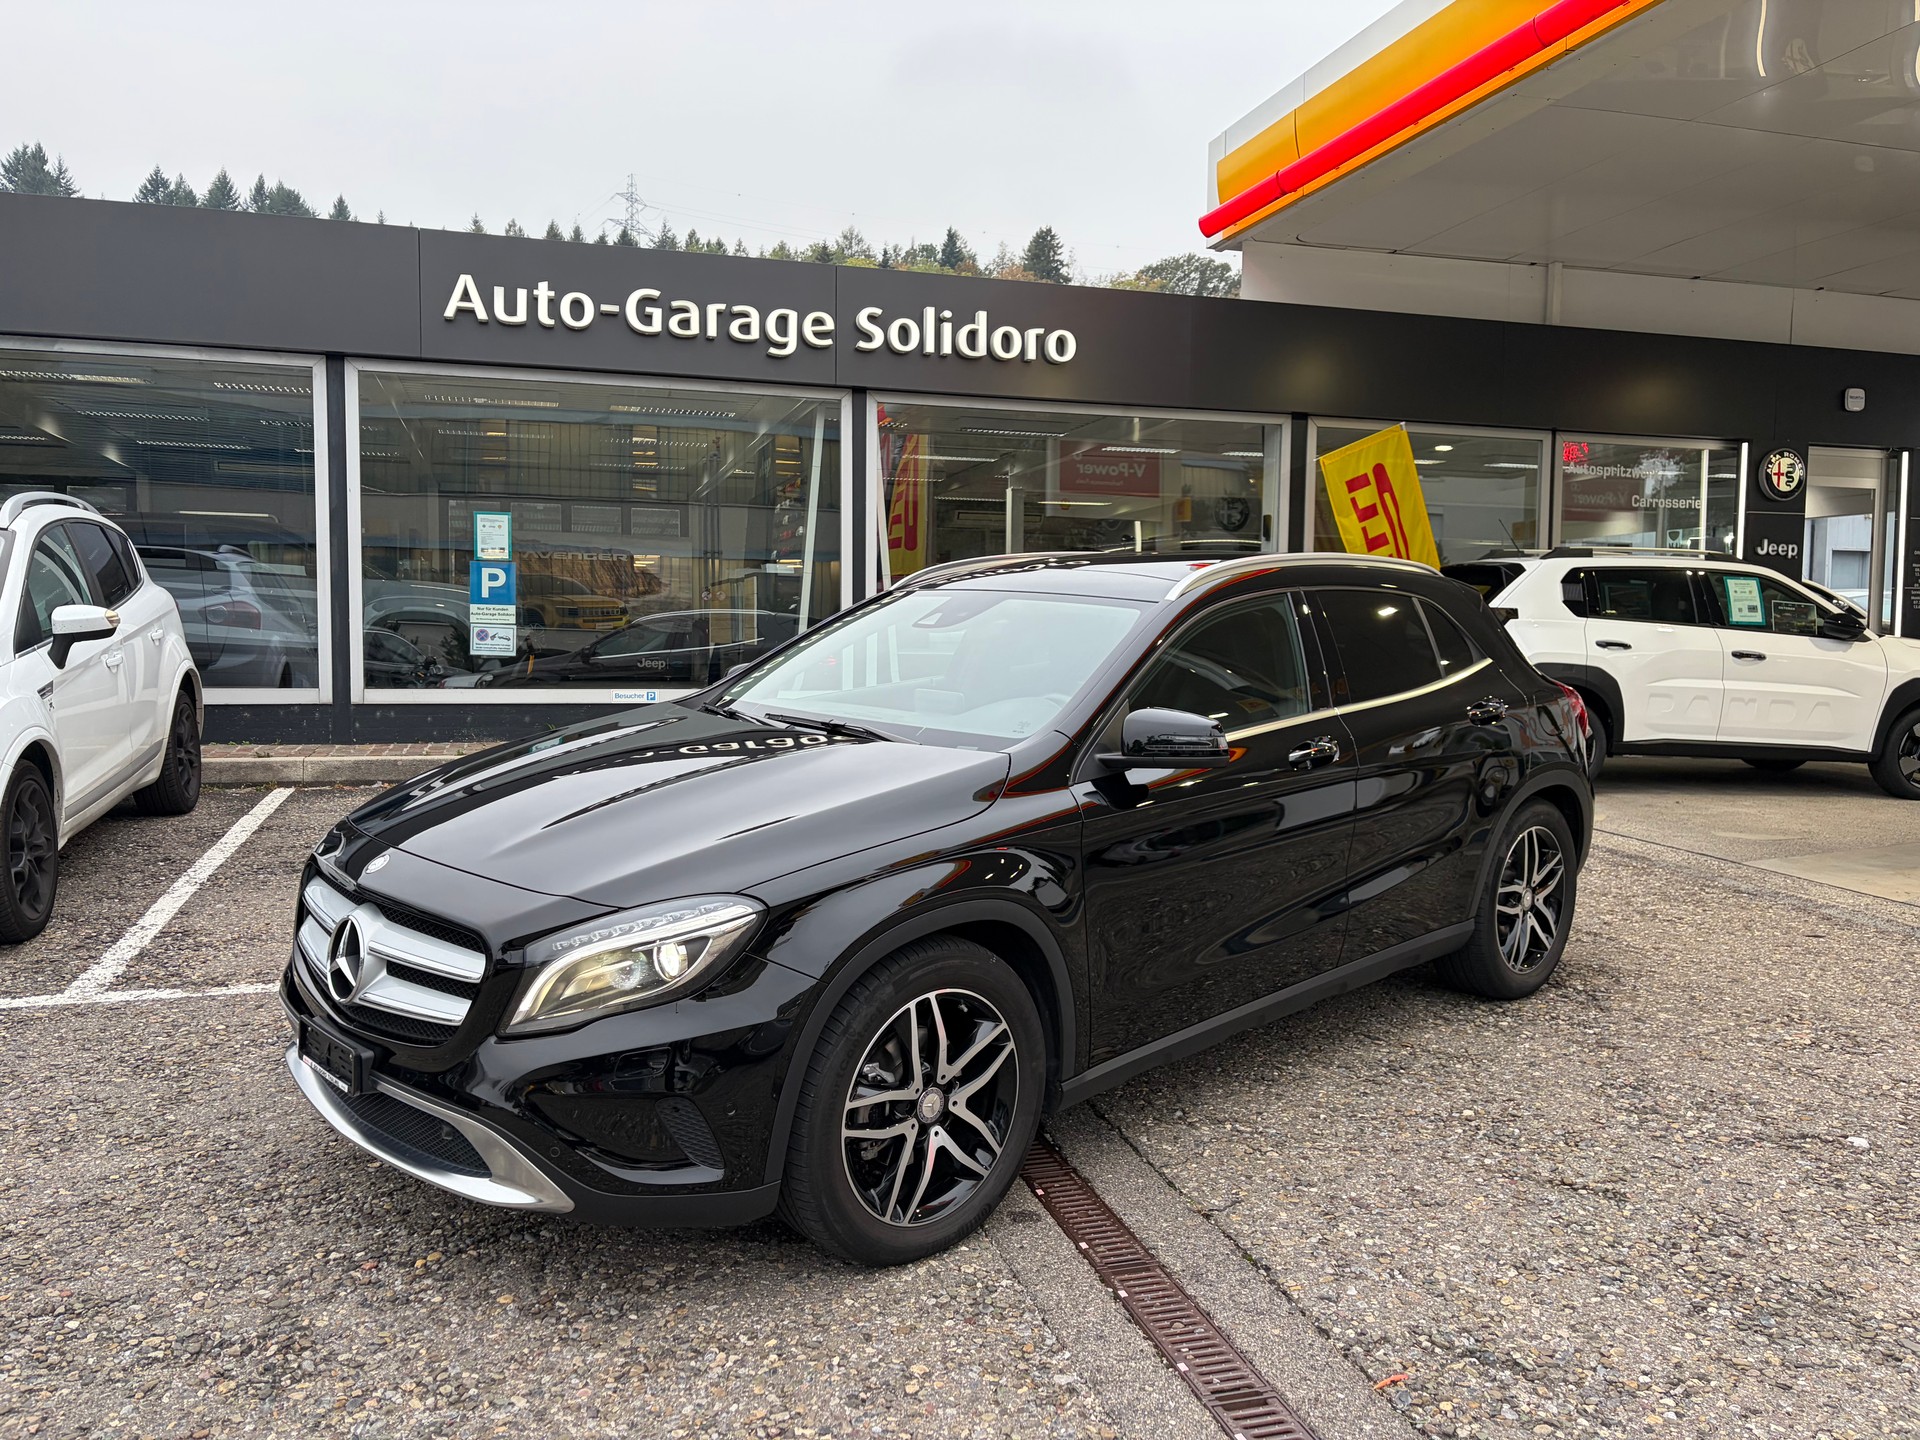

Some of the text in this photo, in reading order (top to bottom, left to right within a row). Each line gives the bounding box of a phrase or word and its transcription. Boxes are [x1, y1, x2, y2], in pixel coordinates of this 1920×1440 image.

[442, 272, 1079, 365] Auto-Garage Solidoro
[1568, 463, 1662, 481] Autospritzwe
[1766, 451, 1804, 477] ALFA ROMEO
[1631, 494, 1702, 510] Carrosserie
[520, 550, 628, 561] AVENGER
[1756, 538, 1799, 560] Jeep
[481, 567, 507, 598] P
[637, 658, 666, 669] Jeep
[1646, 692, 1834, 727] PANDA
